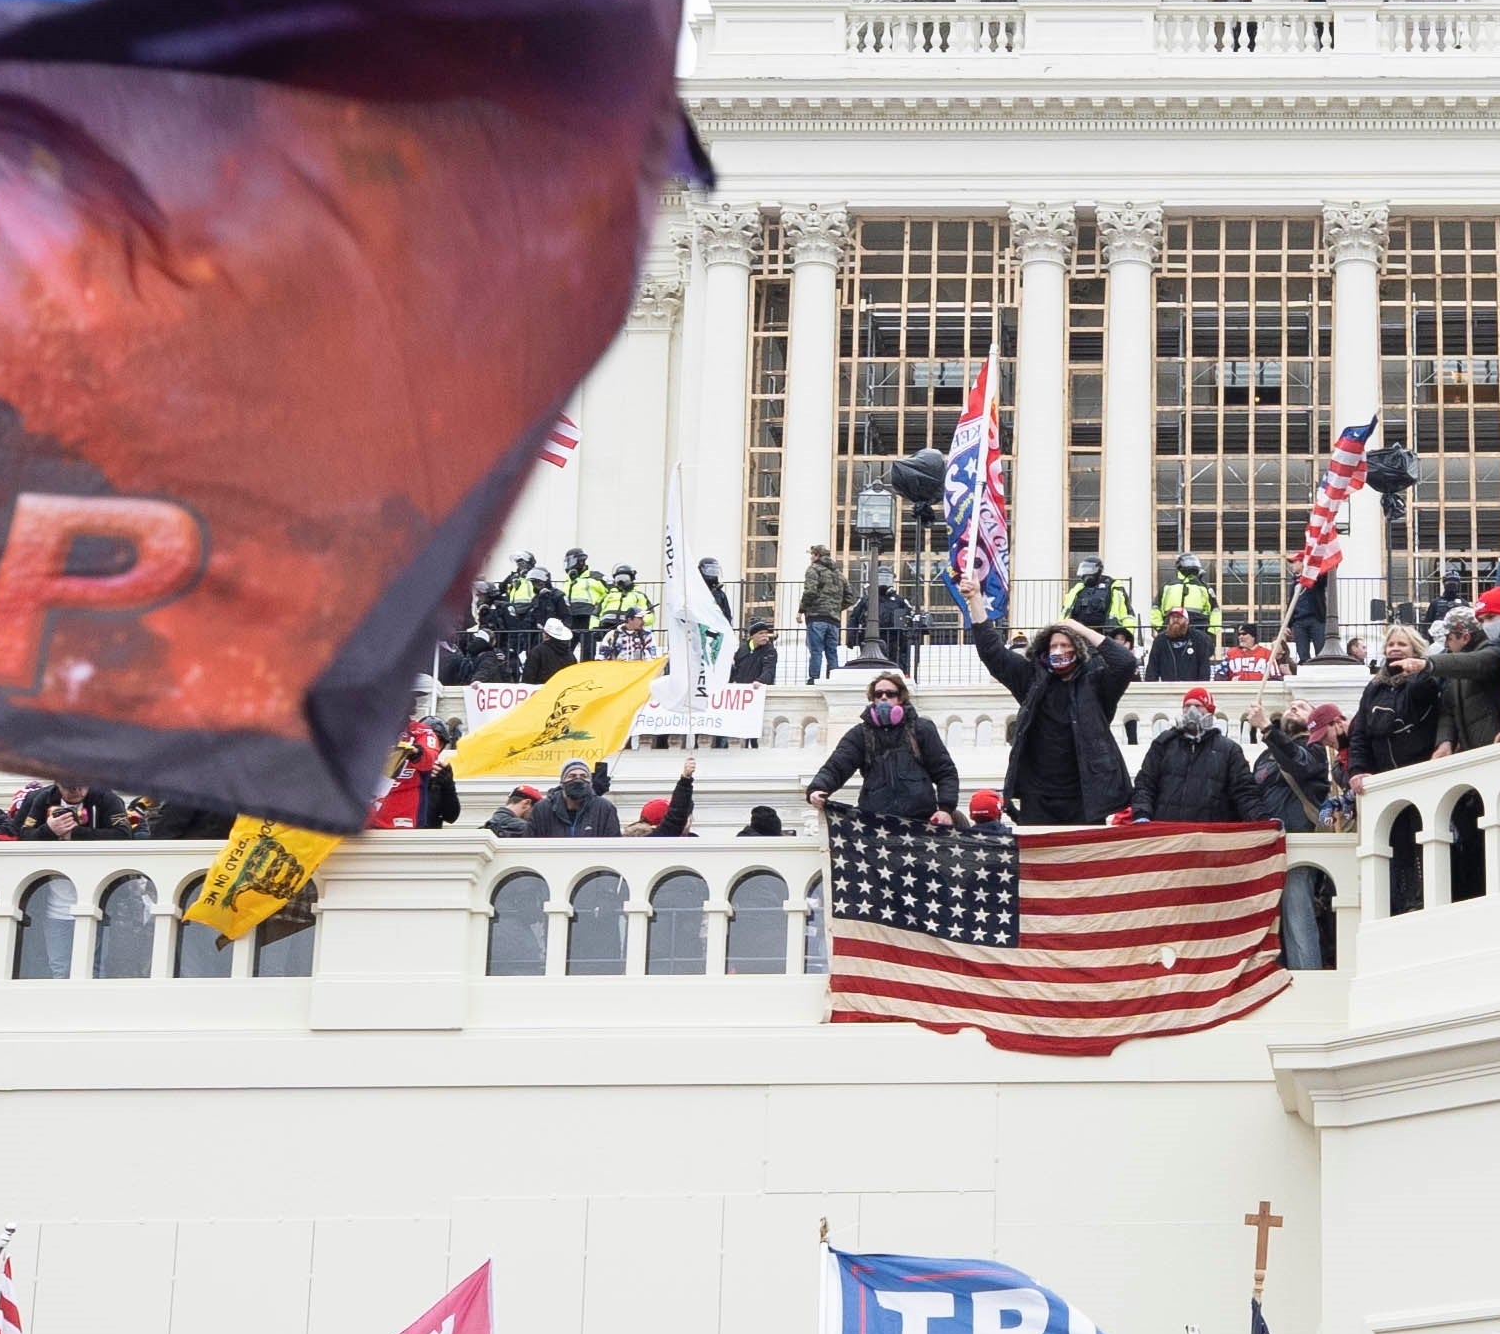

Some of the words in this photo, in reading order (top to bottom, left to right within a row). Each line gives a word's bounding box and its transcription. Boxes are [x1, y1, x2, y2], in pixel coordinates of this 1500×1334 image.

[1229, 657, 1269, 673] USA
[711, 690, 754, 711] UMP
[636, 714, 722, 729] Republicans
[203, 890, 220, 906] ME
